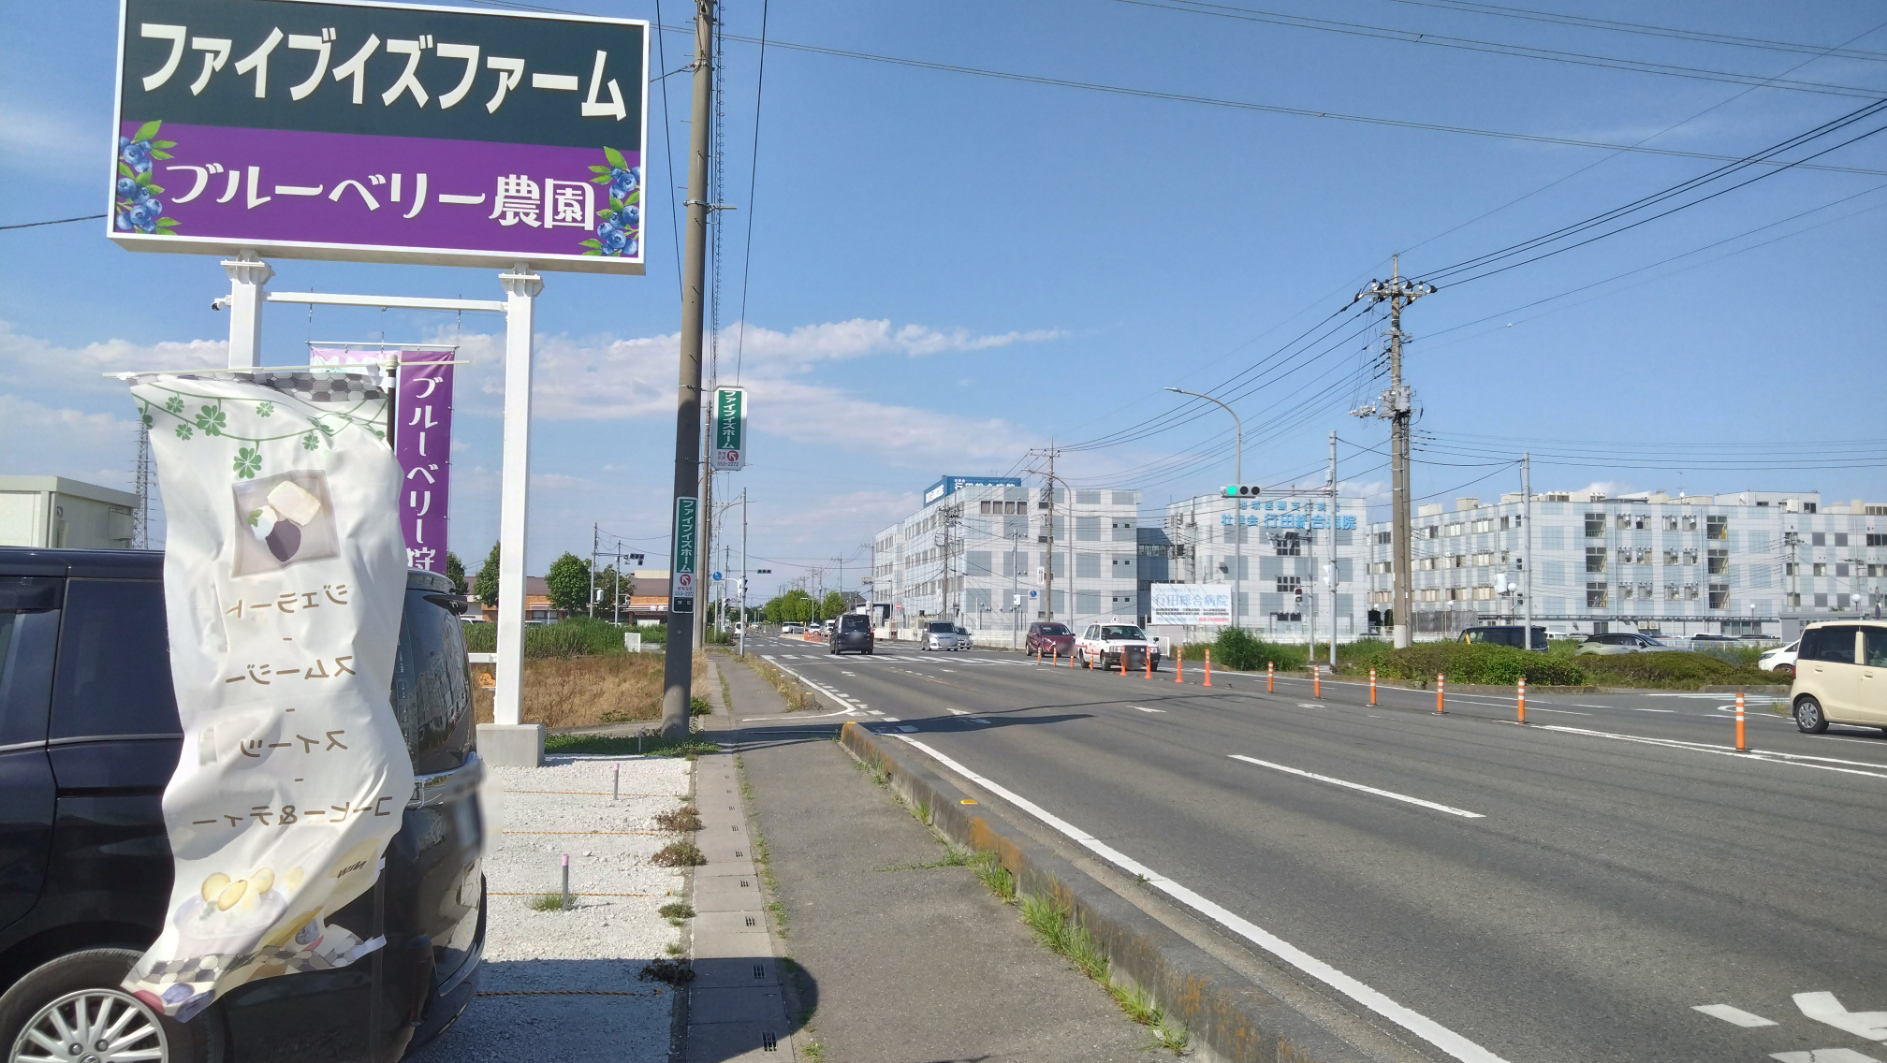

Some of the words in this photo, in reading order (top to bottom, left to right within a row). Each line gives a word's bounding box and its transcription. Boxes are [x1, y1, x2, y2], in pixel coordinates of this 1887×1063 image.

[140, 22, 627, 121] ファイブイズファーム
[166, 162, 595, 231] ブルーベリー農園
[680, 500, 695, 573] ファイブイズホーム
